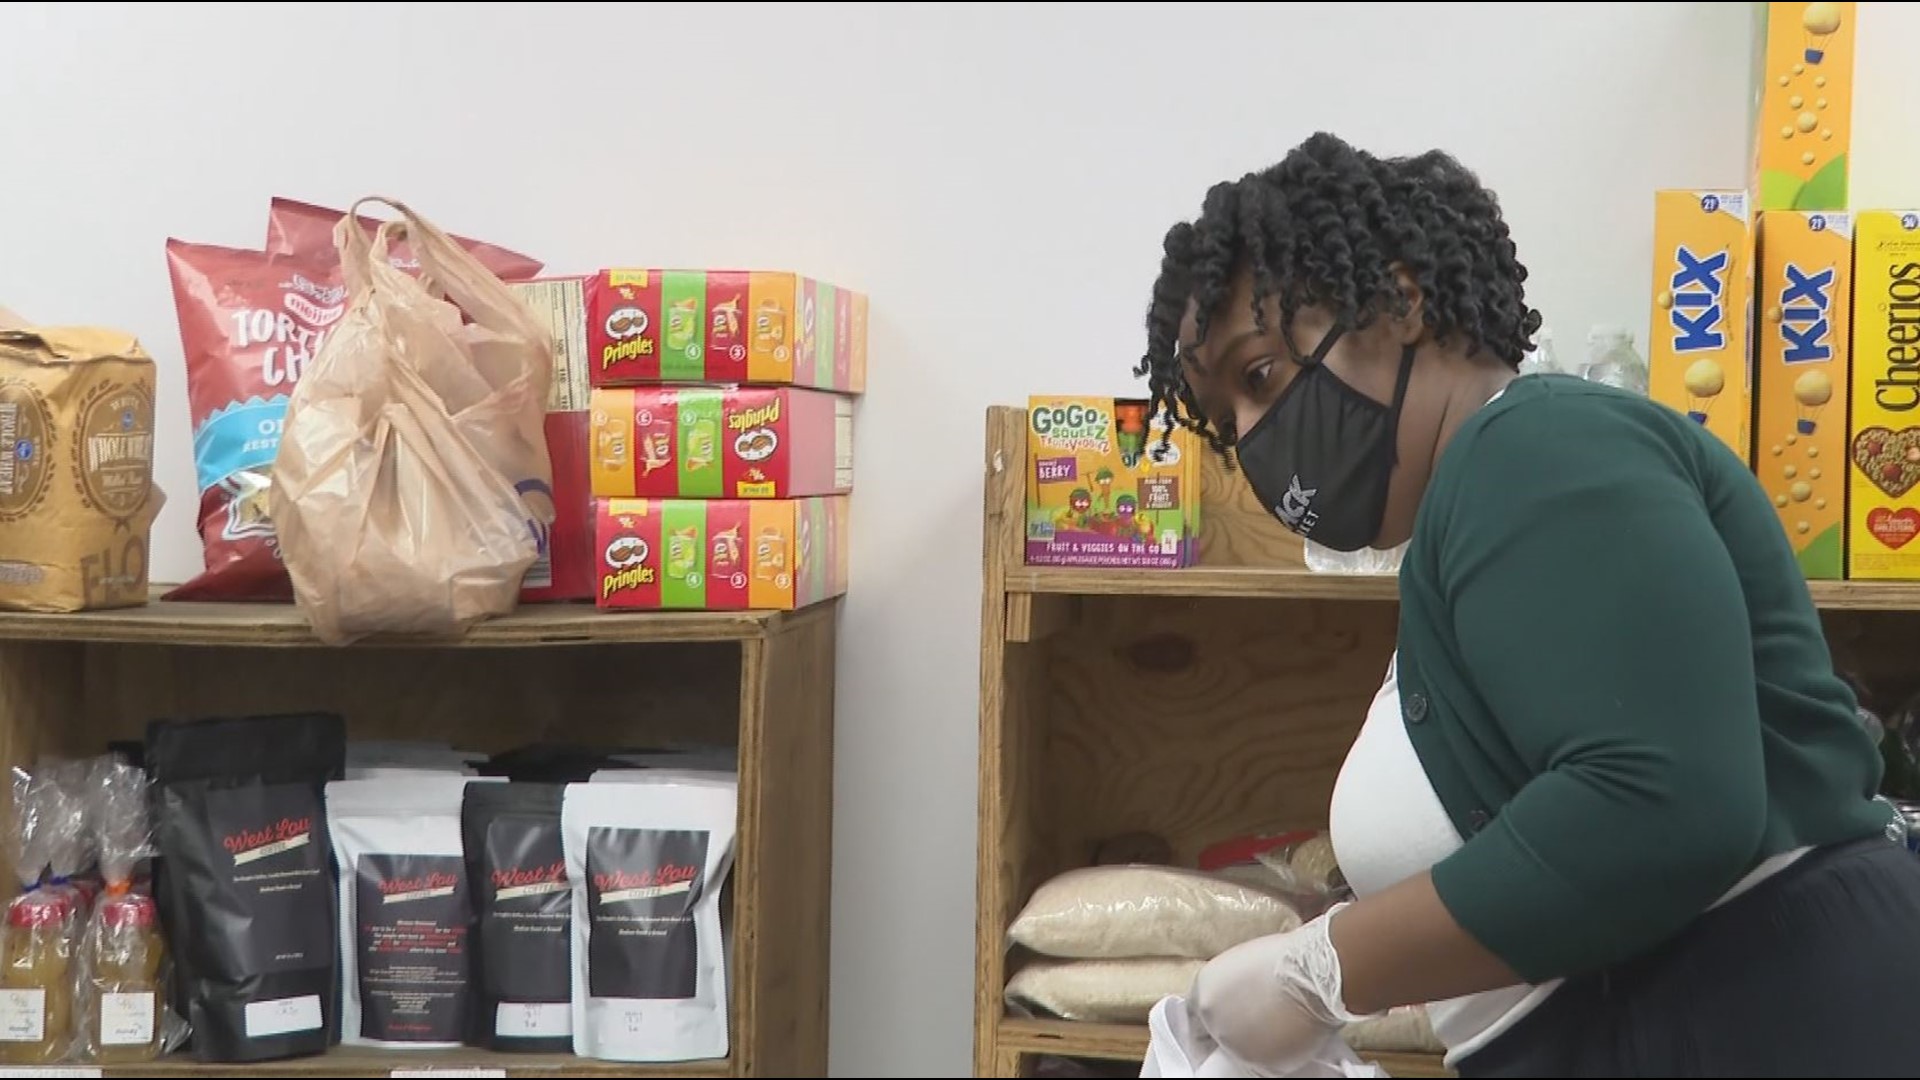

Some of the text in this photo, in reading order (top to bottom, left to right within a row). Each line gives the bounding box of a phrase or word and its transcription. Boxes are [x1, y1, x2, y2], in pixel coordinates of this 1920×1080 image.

[1875, 262, 1920, 411] Cheerios
[602, 336, 654, 370] Pringles
[728, 397, 781, 432] Pringles
[1039, 465, 1071, 479] BERRY
[1046, 543, 1070, 552] FRUIT
[1082, 543, 1115, 553] VEGGIES
[1118, 543, 1130, 553] ON
[1132, 544, 1145, 554] THE
[602, 565, 655, 600] Pringles
[223, 818, 311, 853] West Lou
[378, 872, 458, 894] West Lou
[490, 865, 544, 888] West
[594, 868, 650, 892] West
[655, 863, 696, 887] Lou
